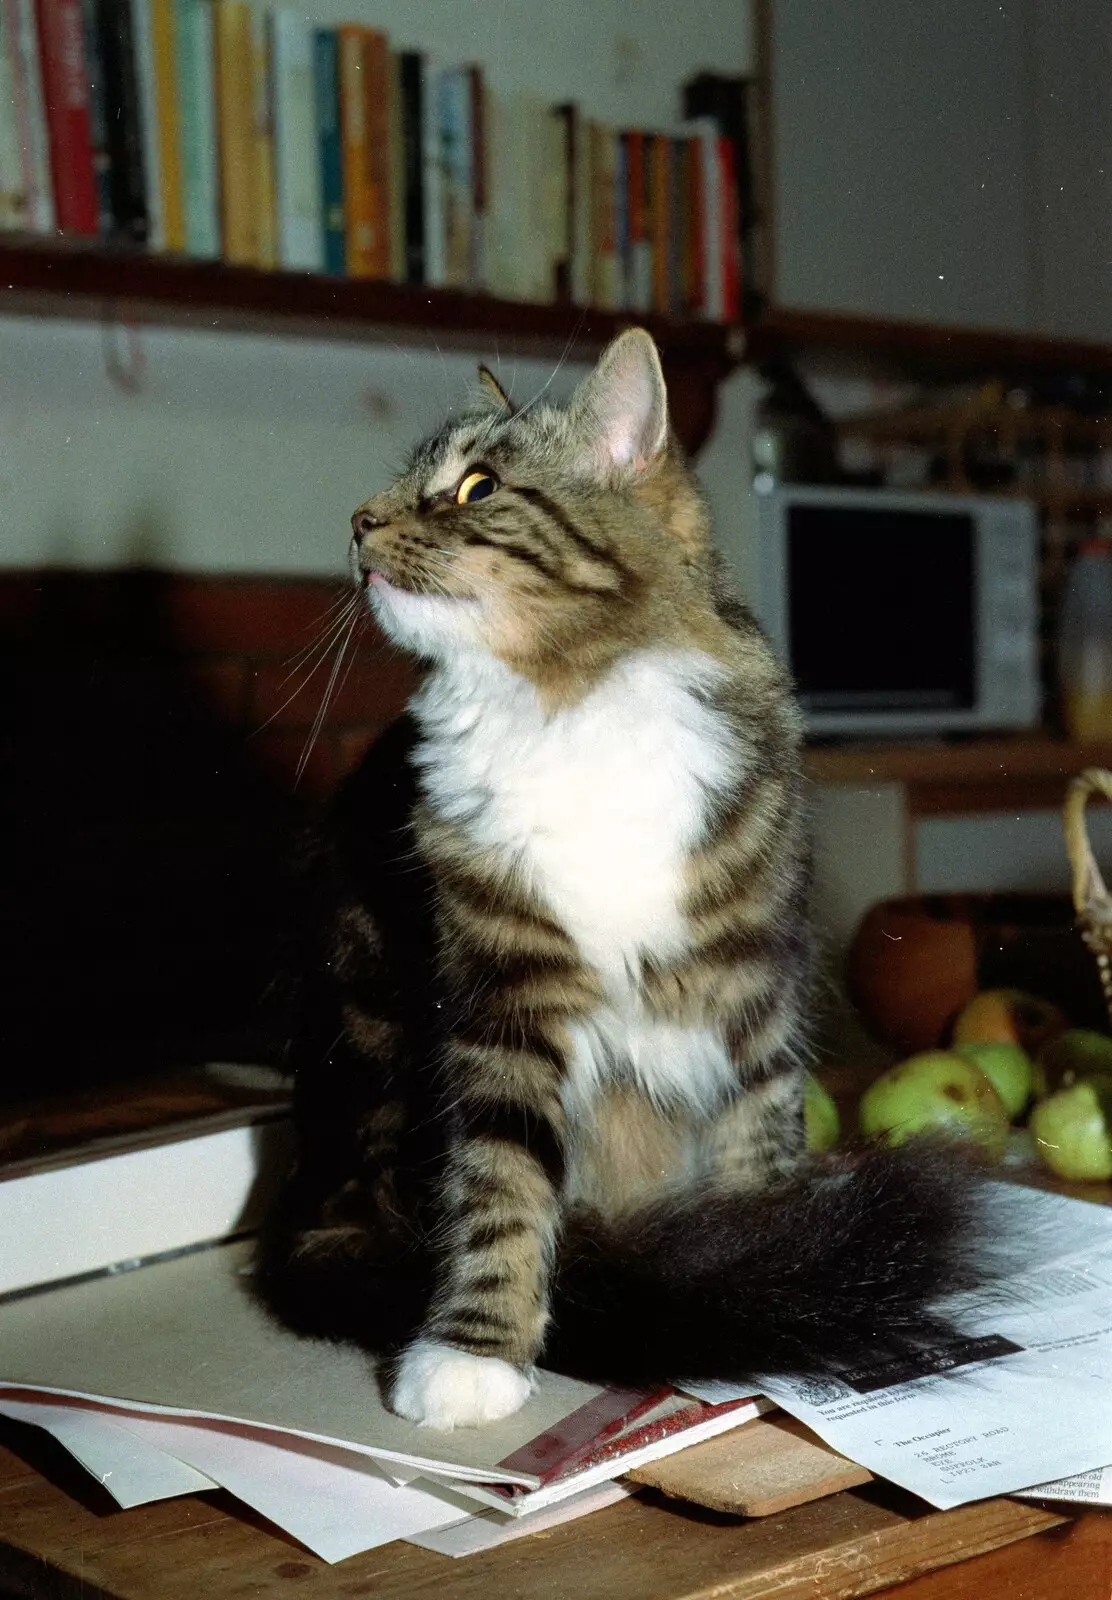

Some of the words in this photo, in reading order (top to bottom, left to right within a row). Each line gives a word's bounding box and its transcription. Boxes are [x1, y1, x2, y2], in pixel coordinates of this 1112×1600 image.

[817, 1408, 835, 1416] You
[837, 1404, 851, 1412] are
[852, 1393, 888, 1406] required
[826, 1407, 867, 1422] requested
[878, 1399, 894, 1408] this
[893, 1439, 912, 1447] The
[912, 1427, 951, 1442] Occupier
[932, 1435, 978, 1453] RECTORY
[981, 1426, 1009, 1438] ROAD
[939, 1456, 987, 1472] SUFFOLK
[1088, 1473, 1102, 1481] old
[1036, 1484, 1076, 1497] withdraw
[1078, 1489, 1100, 1498] them
